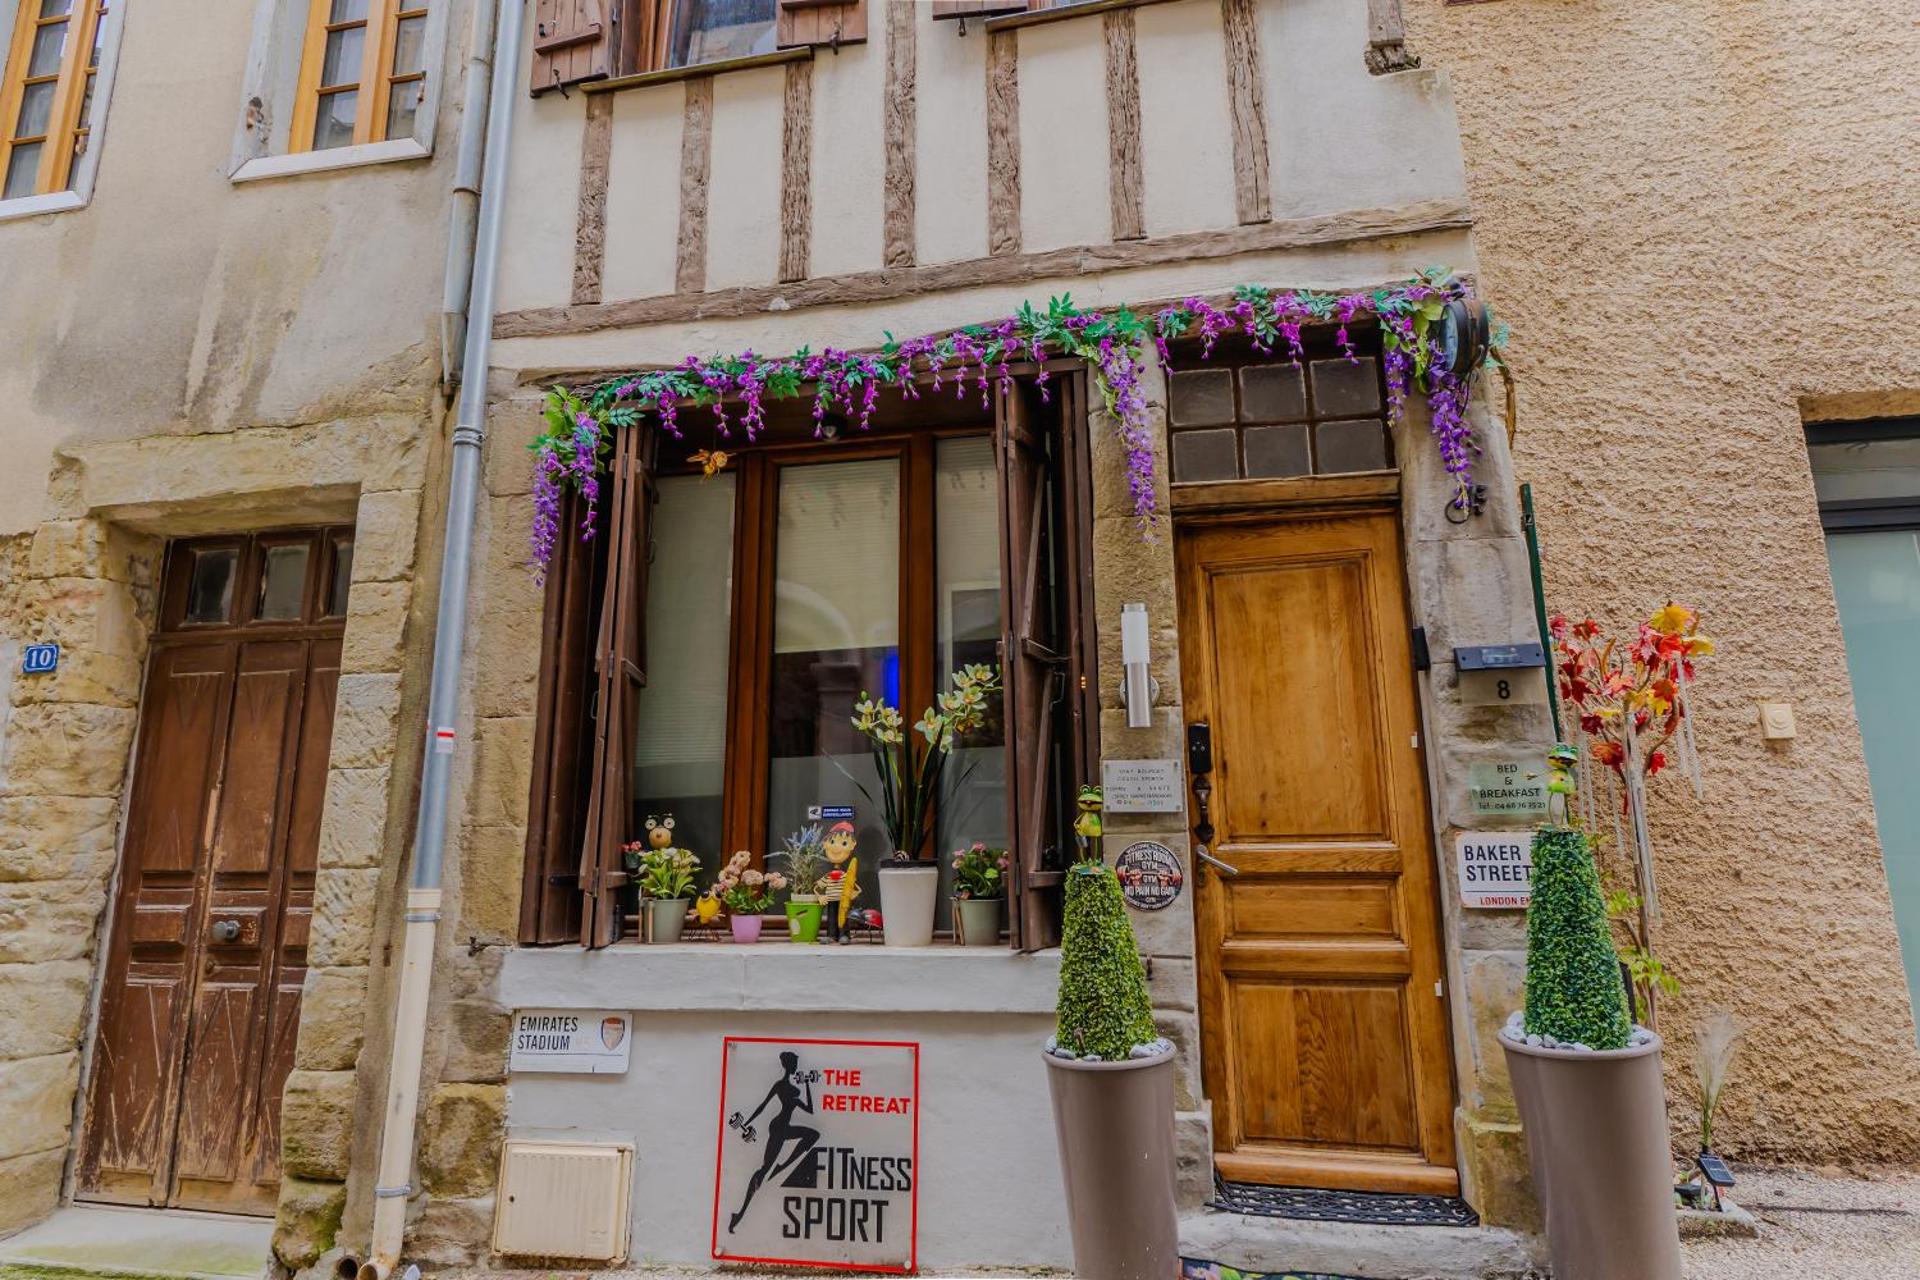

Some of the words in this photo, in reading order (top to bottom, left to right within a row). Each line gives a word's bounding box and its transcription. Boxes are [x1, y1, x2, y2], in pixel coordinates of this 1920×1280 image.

[31, 650, 51, 667] 10
[1497, 680, 1511, 699] 8
[1497, 764, 1518, 774] BED
[1504, 776, 1513, 786] &
[1480, 788, 1540, 799] BREAKFAST
[1464, 845, 1522, 861] BAKER
[1141, 860, 1158, 870] GYM
[1466, 865, 1534, 882] STREET
[1124, 886, 1134, 896] NO
[1135, 886, 1151, 896] PAIN
[1151, 886, 1160, 896] NO
[1480, 896, 1518, 906] LONDON
[520, 1016, 578, 1032] EMIRATES
[518, 1034, 571, 1051] STADIUM
[823, 1069, 861, 1087] THE
[822, 1094, 911, 1114] RETREAT
[812, 1146, 912, 1191] FITNESS
[782, 1196, 889, 1243] SPORT
